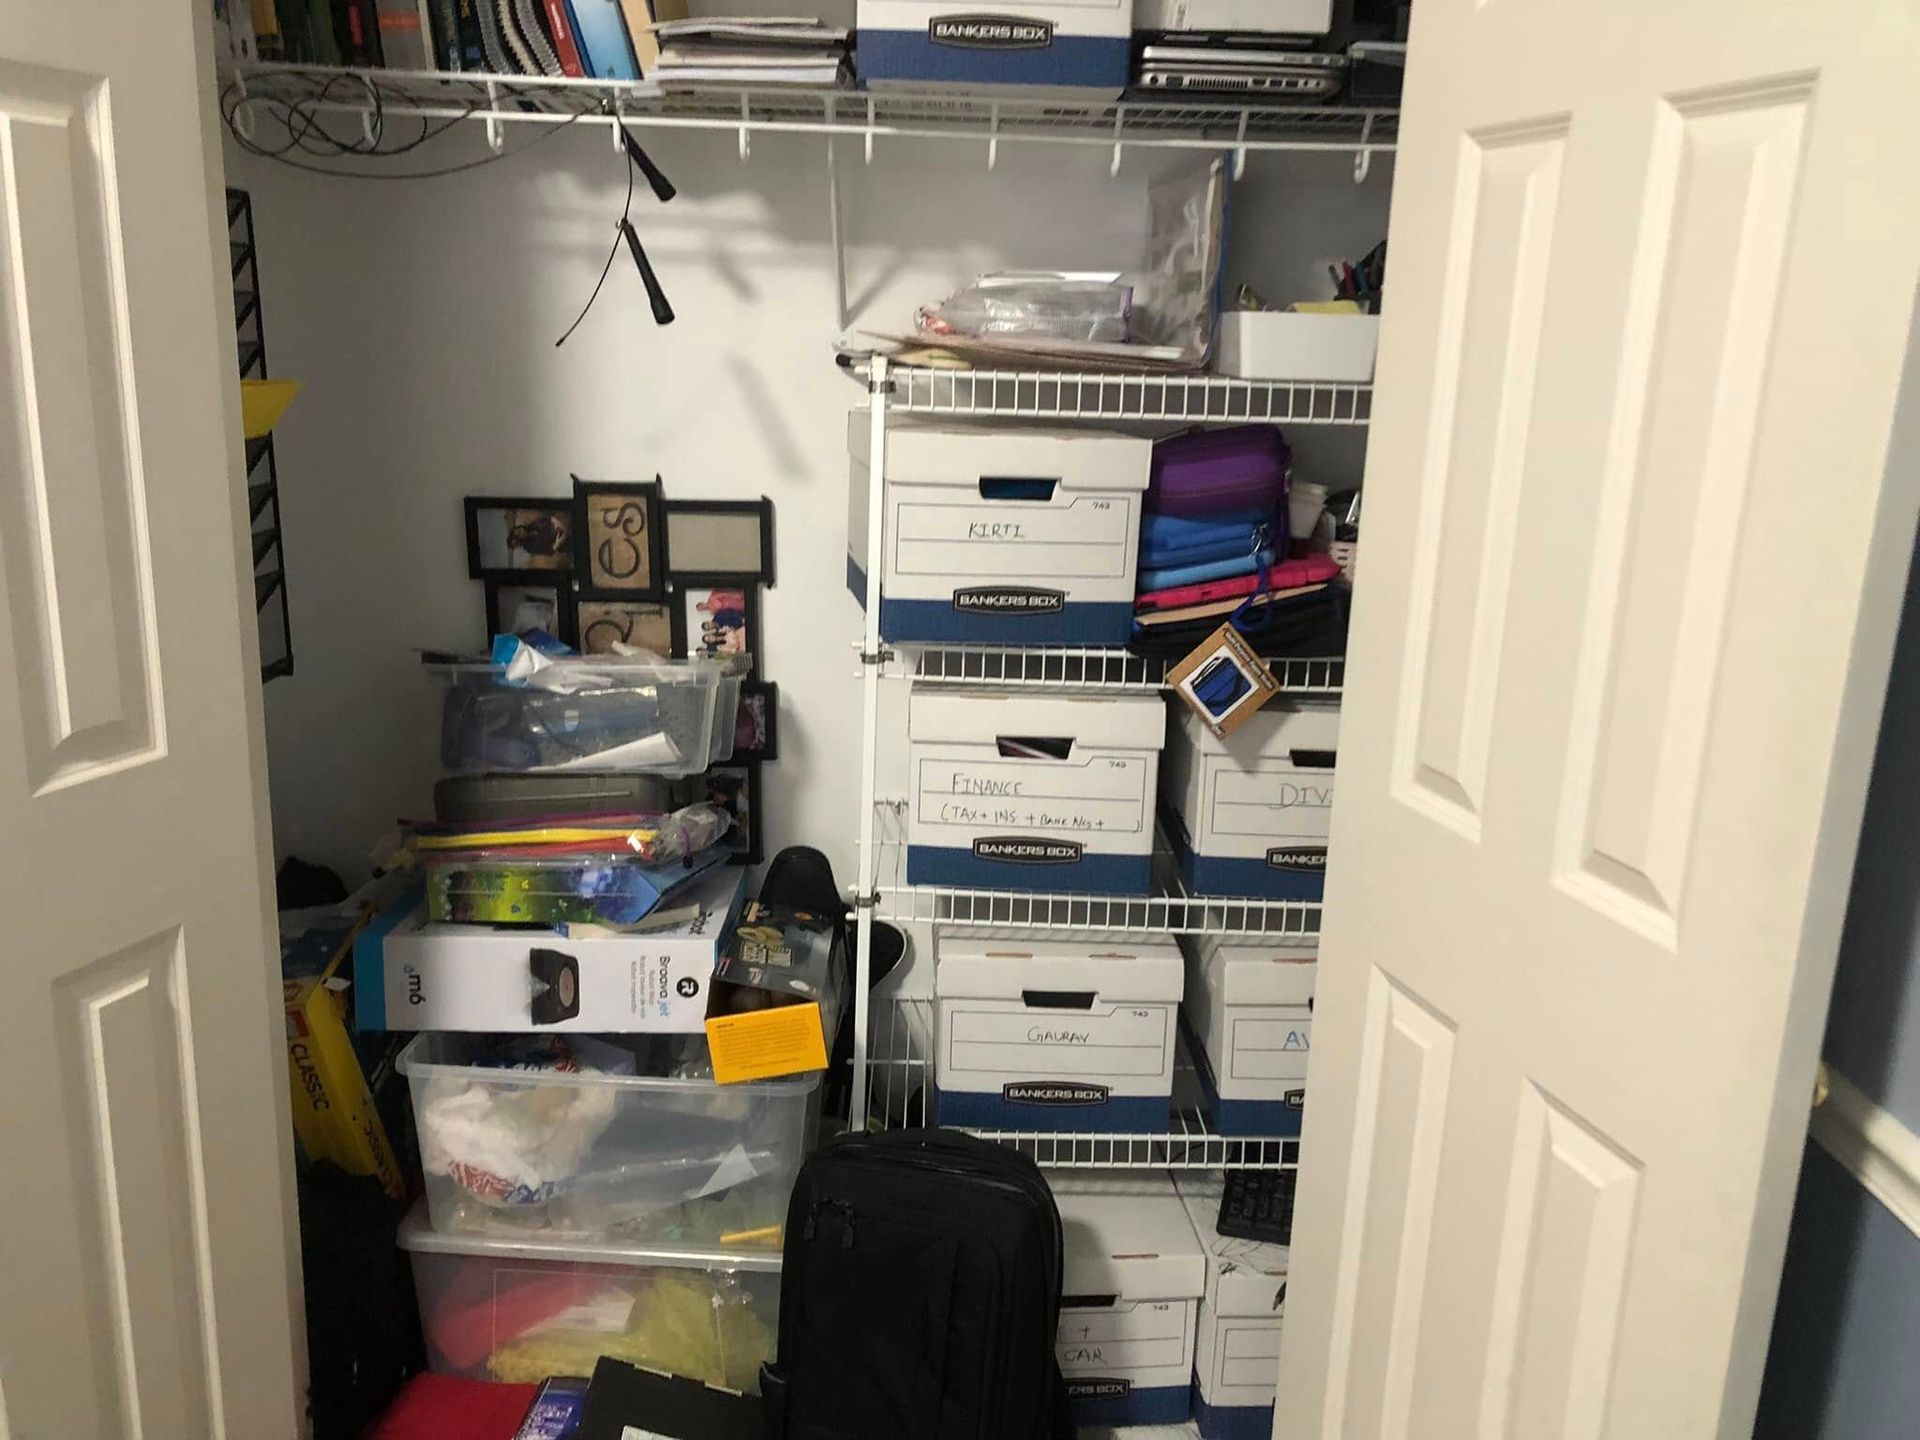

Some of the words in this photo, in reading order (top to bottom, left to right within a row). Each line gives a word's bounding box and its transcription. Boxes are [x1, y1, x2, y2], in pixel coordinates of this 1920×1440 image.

[936, 23, 1011, 39] BANKERS
[1012, 25, 1046, 40] BOX
[968, 521, 1026, 539] KIRTI
[959, 594, 1026, 607] BANKERS
[1027, 594, 1060, 608] BOX
[951, 772, 1023, 795] FINANCE
[1269, 783, 1334, 809] DIV
[979, 843, 1044, 857] BANKERS
[1046, 845, 1077, 858] BOX
[1272, 853, 1327, 865] BANKER
[1131, 1010, 1149, 1018] 743
[1027, 1026, 1090, 1044] GAURAV
[290, 1043, 331, 1111] CLASSIC
[1009, 1088, 1073, 1099] BANKERS
[1074, 1090, 1103, 1100] BOX
[1096, 1383, 1124, 1394] BOX
